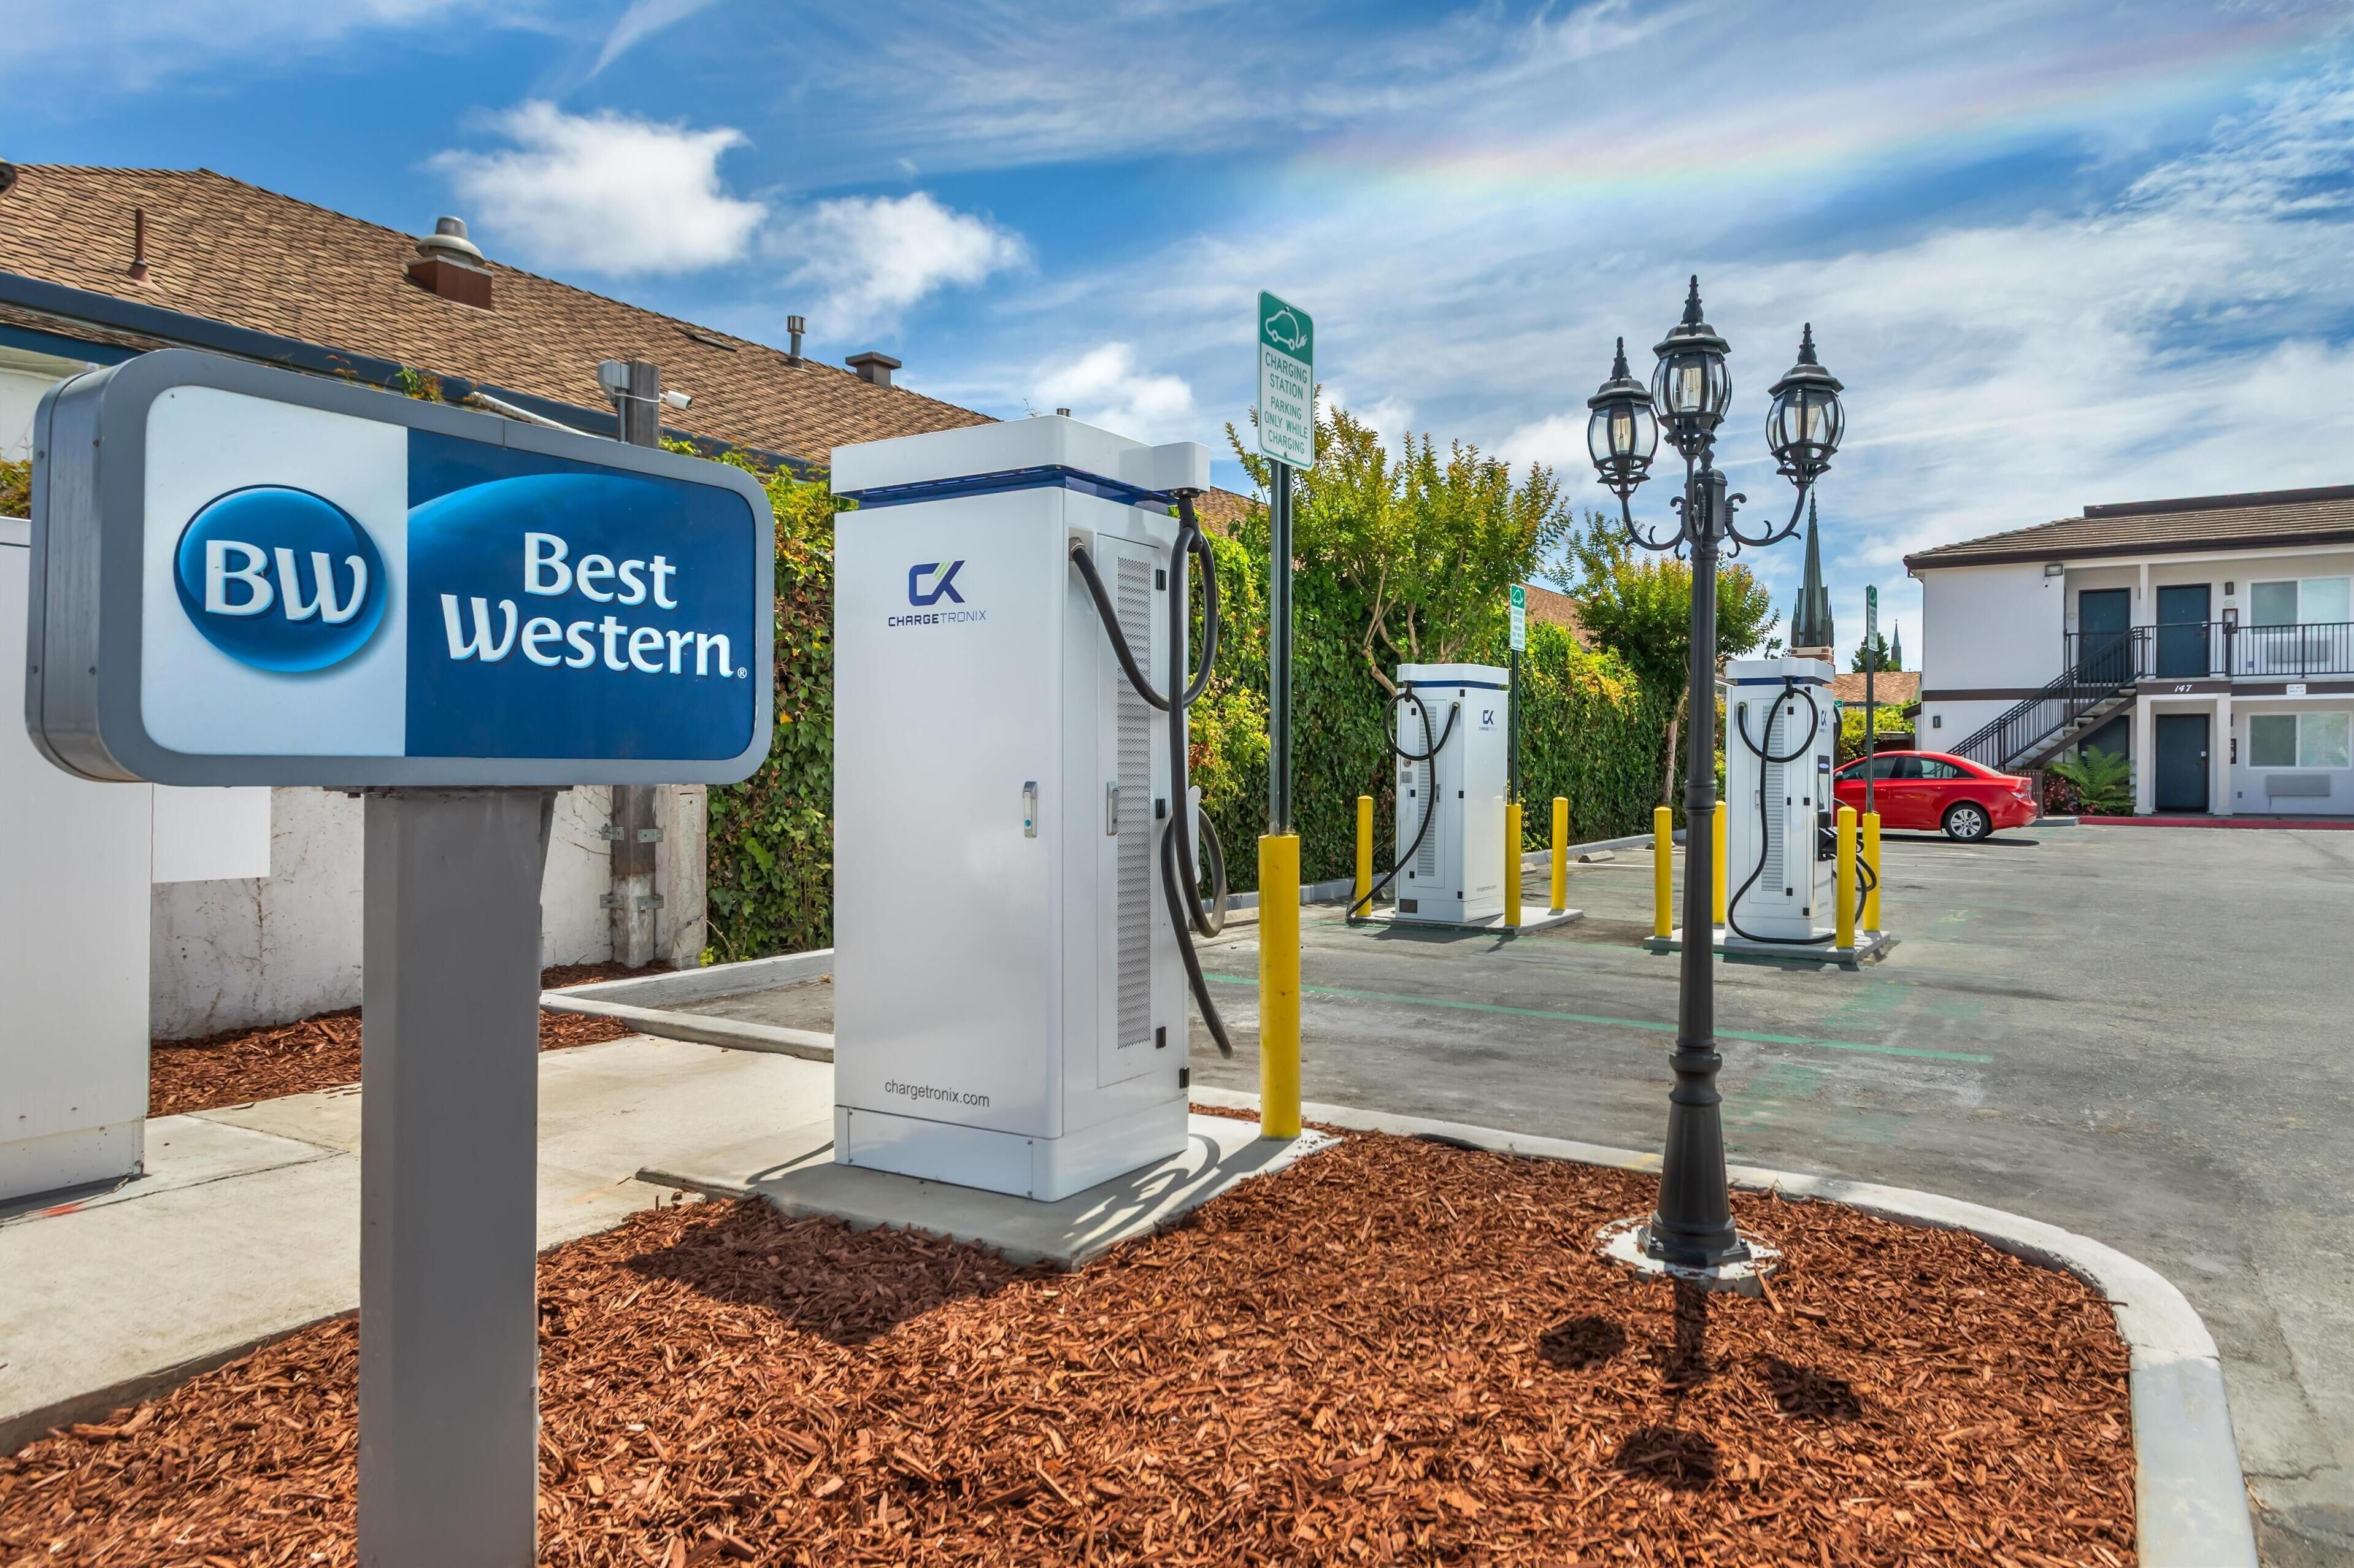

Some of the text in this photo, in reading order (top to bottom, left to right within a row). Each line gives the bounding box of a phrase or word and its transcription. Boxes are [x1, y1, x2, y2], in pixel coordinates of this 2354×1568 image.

[1266, 352, 1307, 383] CHARGING
[1270, 373, 1303, 401] STATION
[1271, 396, 1302, 420] PARKING
[1264, 410, 1308, 439] ONLY WHILE
[1268, 429, 1304, 454] CHARGING
[206, 540, 367, 623] BW
[525, 532, 677, 610] Best
[888, 610, 987, 627] CHARGETRONIX
[2174, 684, 2193, 693] 147
[885, 1079, 990, 1107] chargetronix.com
